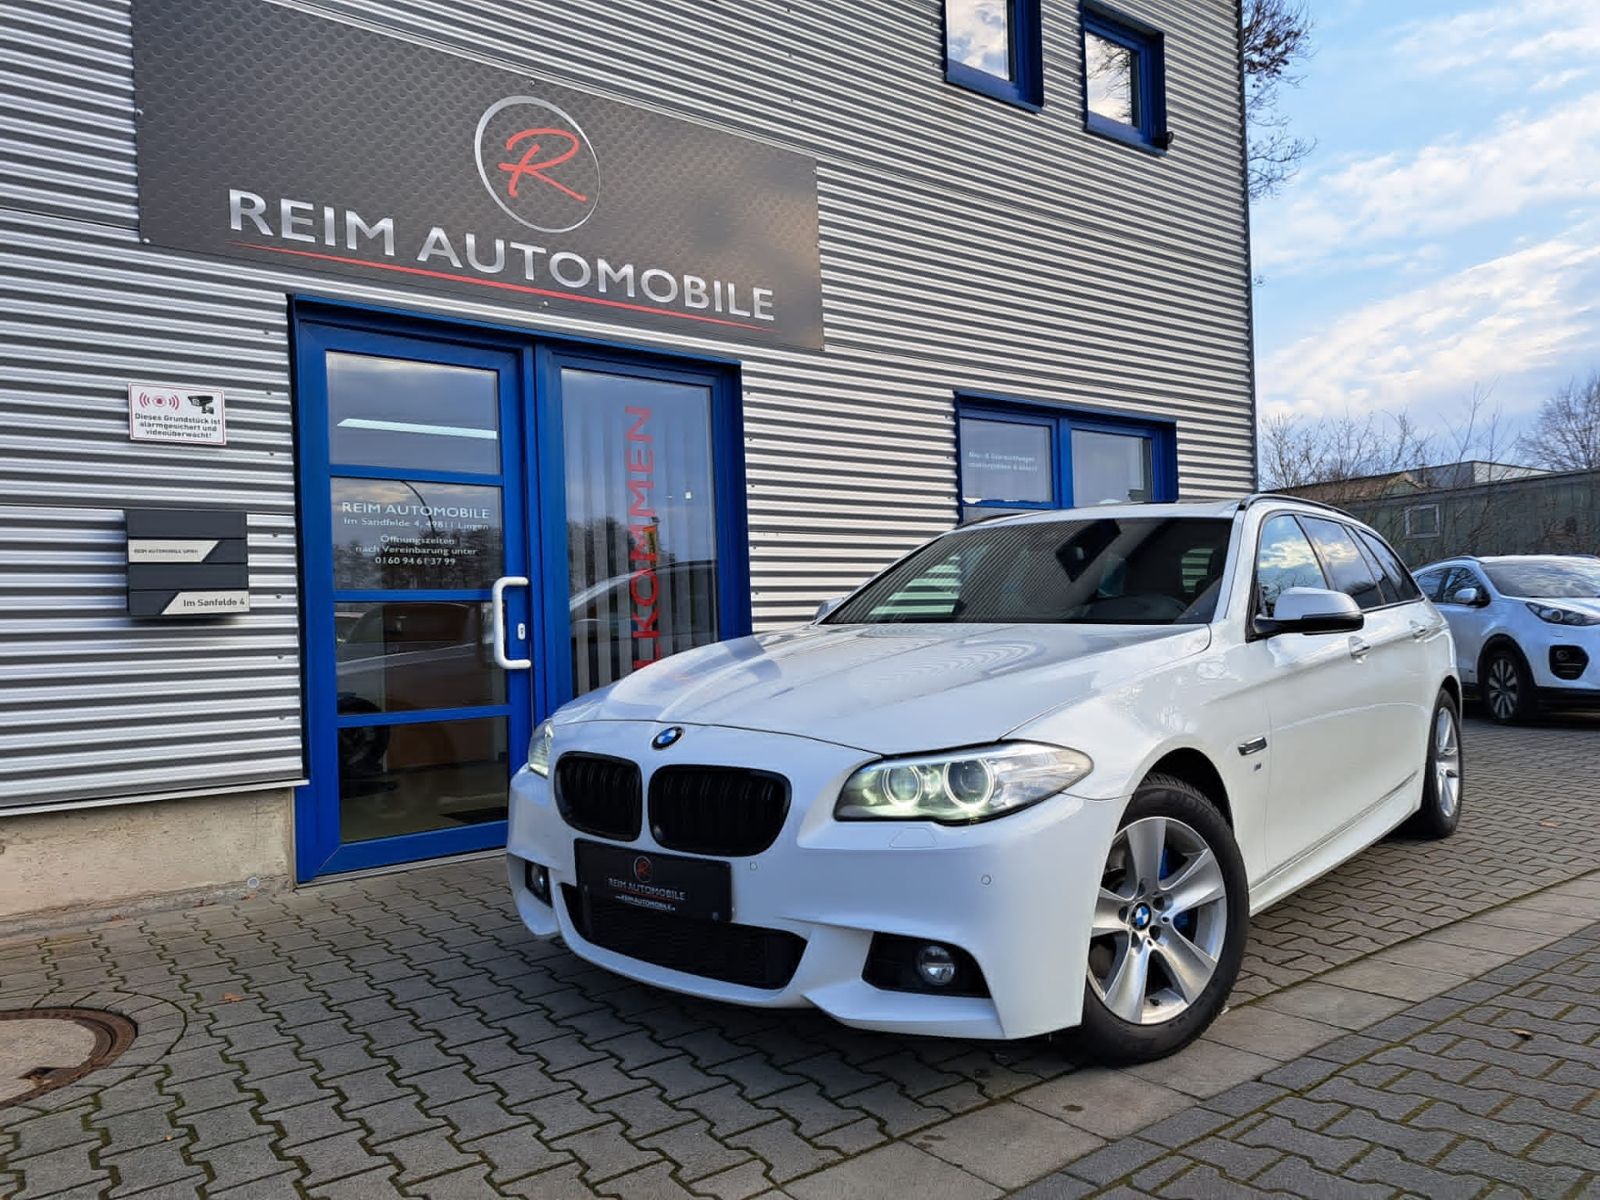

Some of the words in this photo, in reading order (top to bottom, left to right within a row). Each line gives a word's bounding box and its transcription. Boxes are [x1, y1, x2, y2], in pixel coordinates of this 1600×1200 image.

[498, 127, 587, 202] R
[228, 188, 395, 256] REIM
[416, 226, 775, 321] AUTOMOBILE
[135, 413, 162, 422] Dieses
[164, 415, 209, 424] Grundstück
[140, 421, 200, 431] alarmgesichert
[145, 429, 212, 438] videoüberwacht!
[342, 502, 381, 514] REIM
[385, 504, 491, 519] AUTOMOBILE
[344, 517, 358, 525] Im
[362, 518, 410, 527] Sandfelde
[356, 545, 380, 553] nach
[383, 546, 449, 556] Vereinbarung
[451, 547, 477, 555] unter
[183, 599, 196, 607] Im
[239, 598, 245, 606] 4
[628, 883, 687, 901] AUTOMOBILE
